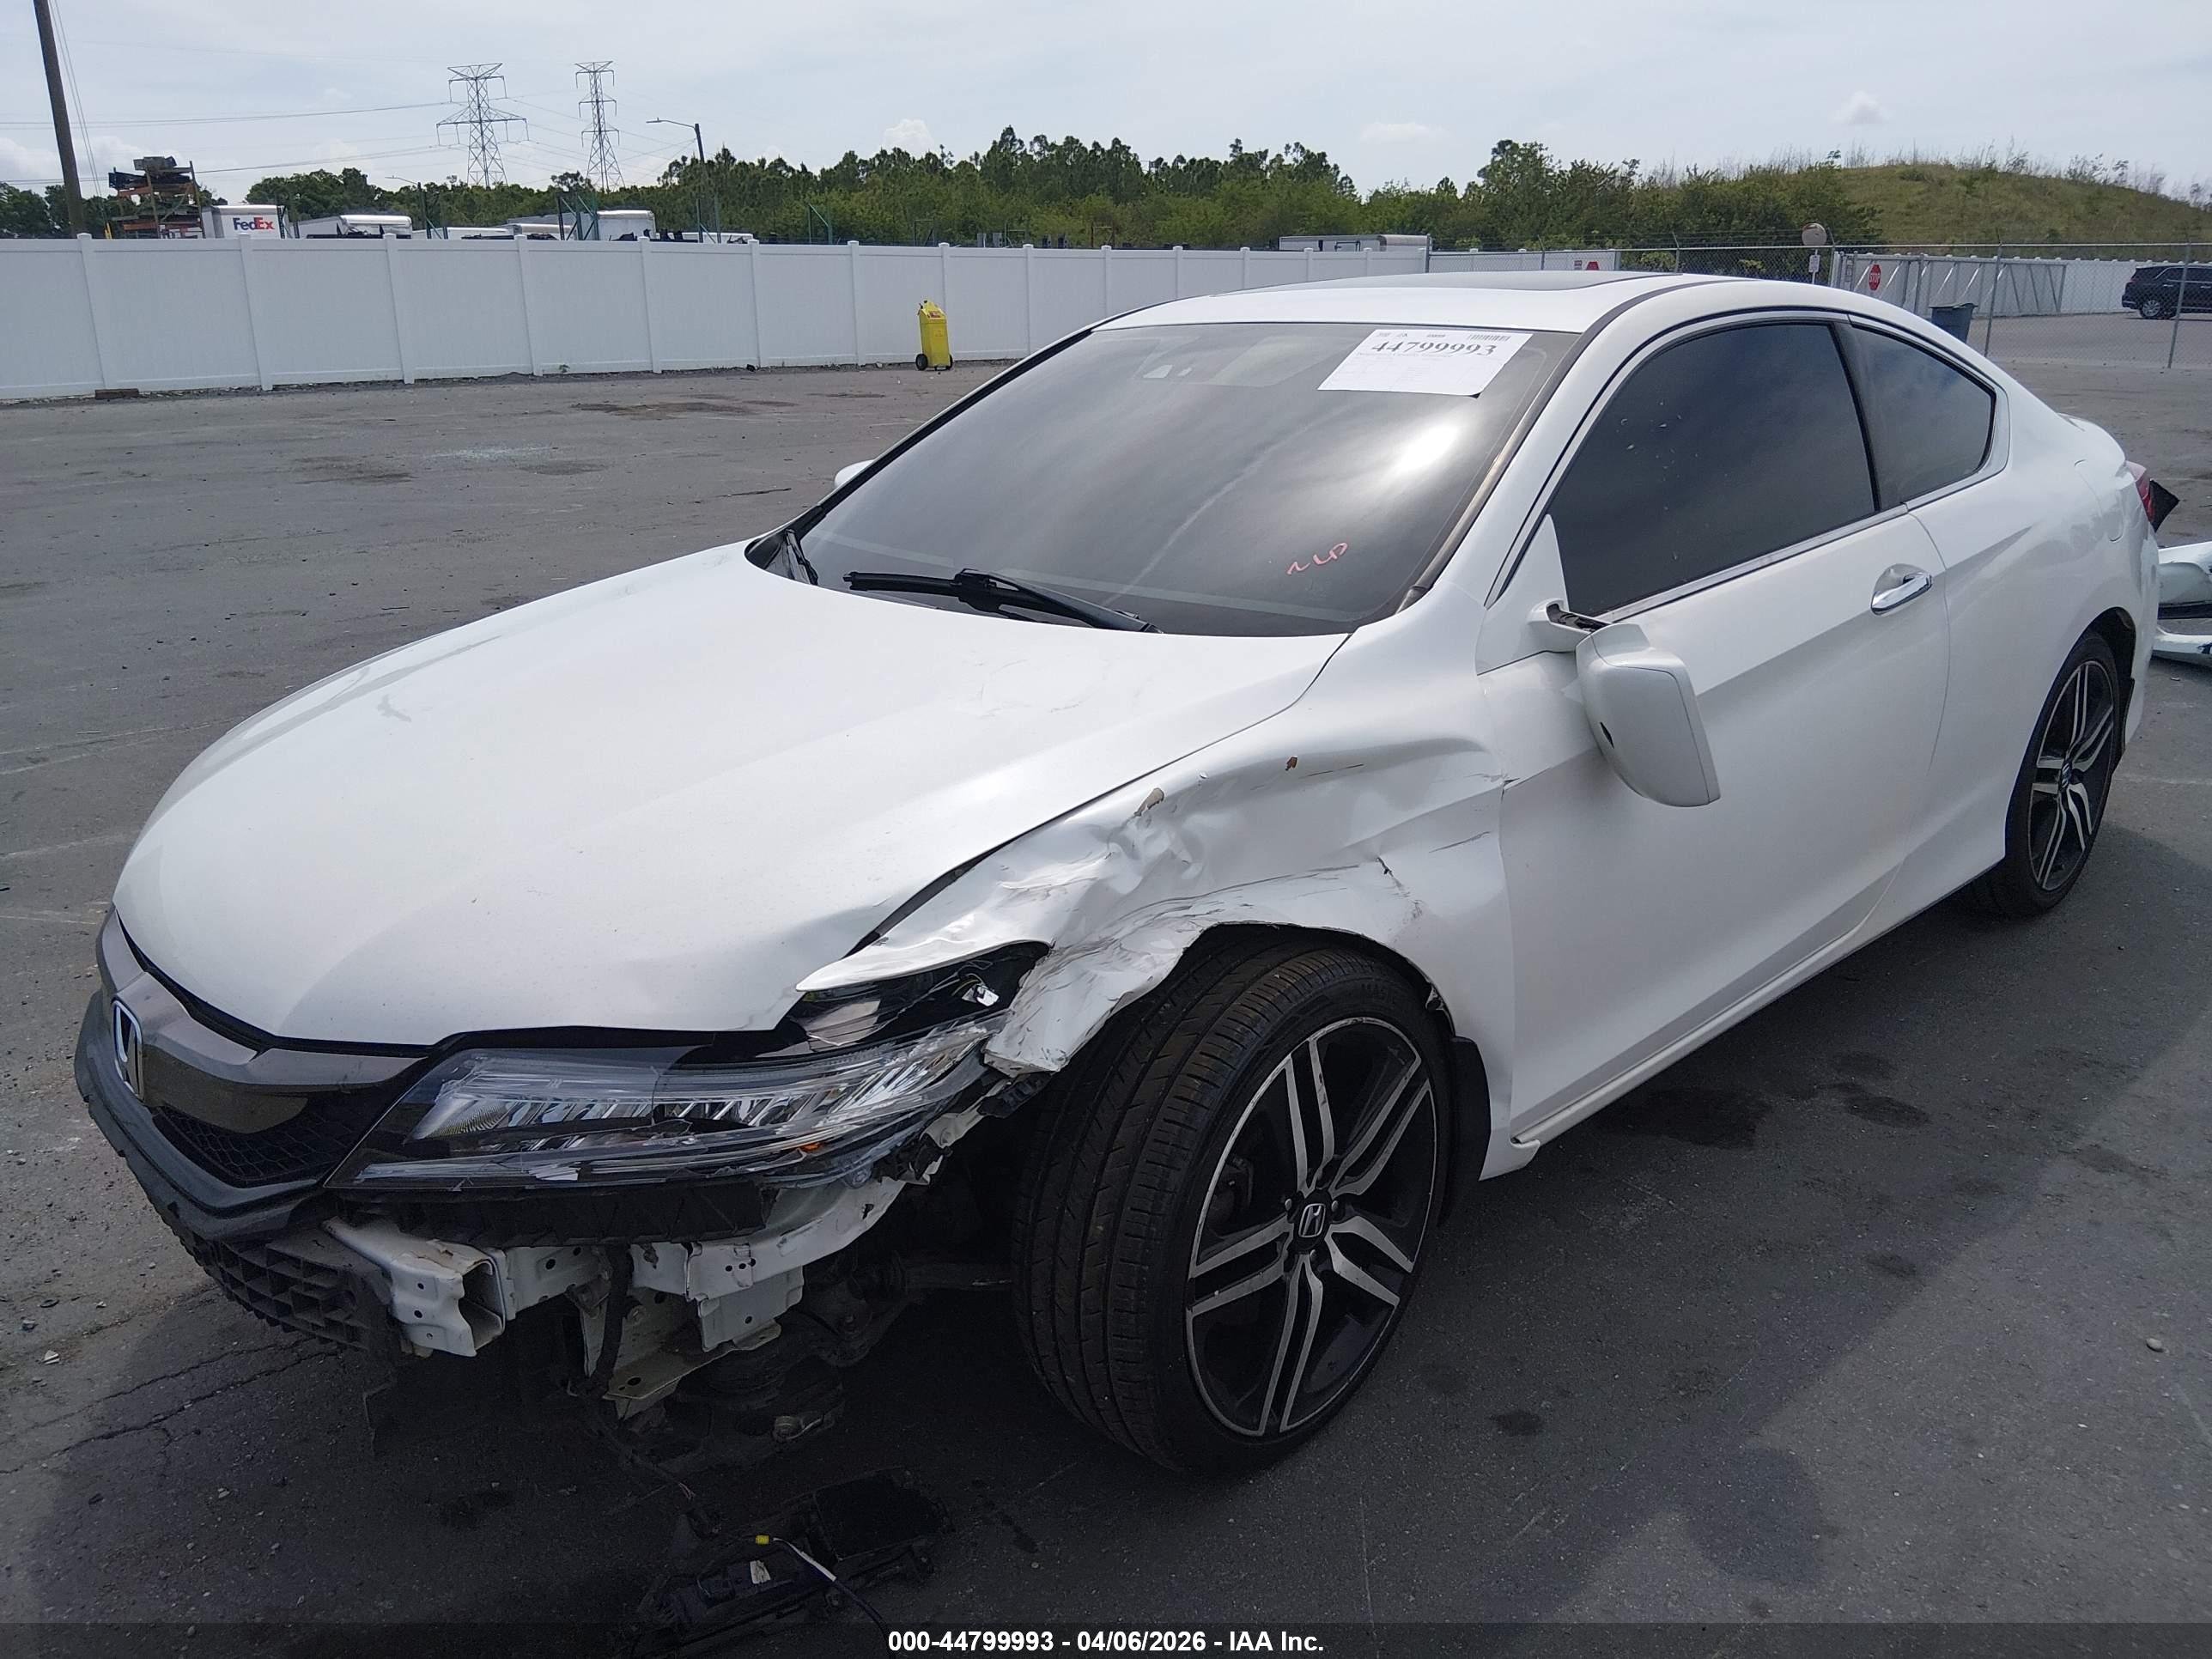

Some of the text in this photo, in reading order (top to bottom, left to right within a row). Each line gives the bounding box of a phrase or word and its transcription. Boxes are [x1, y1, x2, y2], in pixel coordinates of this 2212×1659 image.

[233, 216, 275, 231] FedEx
[1869, 273, 1881, 283] STOP
[1371, 340, 1497, 356] 44799993
